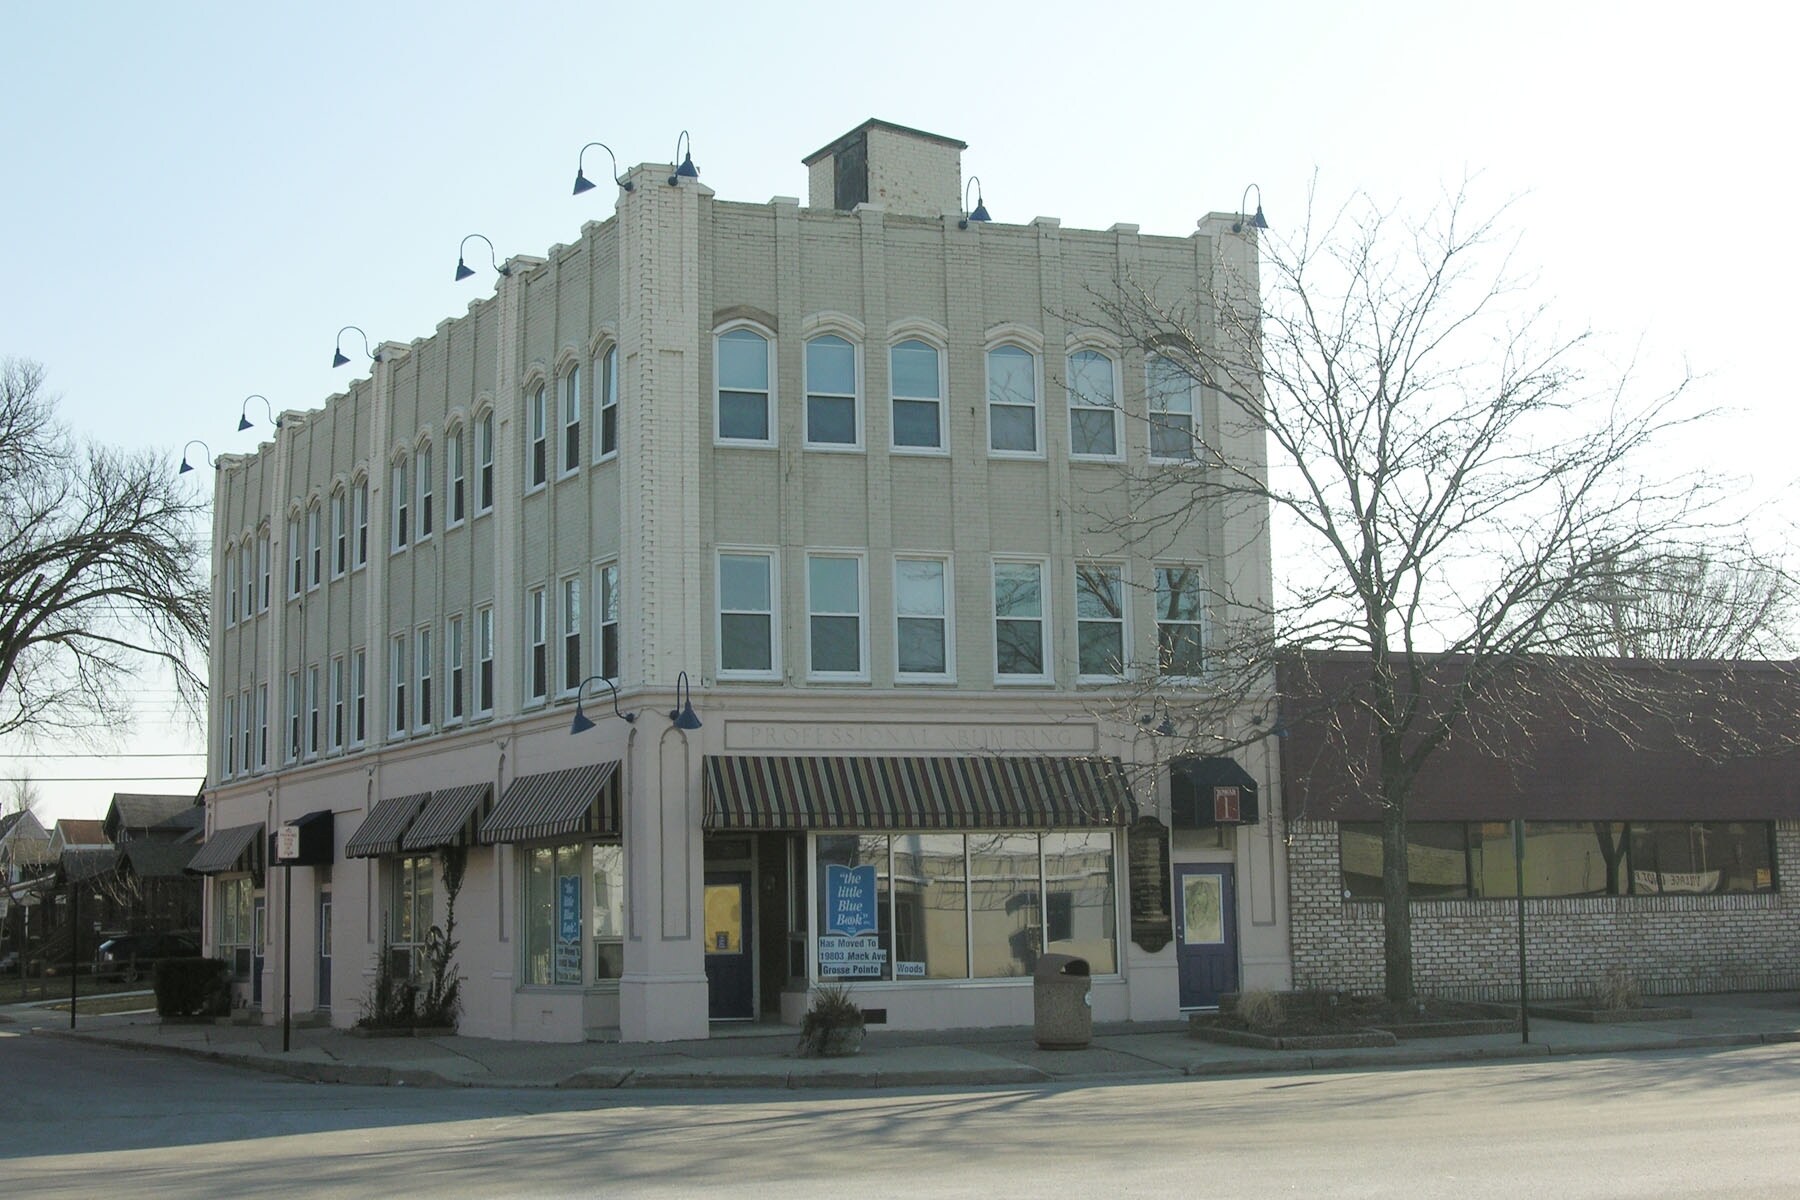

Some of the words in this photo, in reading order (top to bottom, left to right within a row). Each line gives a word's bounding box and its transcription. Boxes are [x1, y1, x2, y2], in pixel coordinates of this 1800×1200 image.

[838, 886, 862, 898] little
[838, 900, 862, 912] Blue
[820, 937, 835, 948] Has
[838, 937, 865, 948] Moved
[868, 937, 877, 948] To
[820, 951, 845, 961] 19803
[847, 951, 870, 961] Mack
[871, 951, 887, 961] Ave
[823, 964, 850, 975] Grosse
[853, 964, 879, 974] Pointe
[897, 963, 924, 974] Woods
